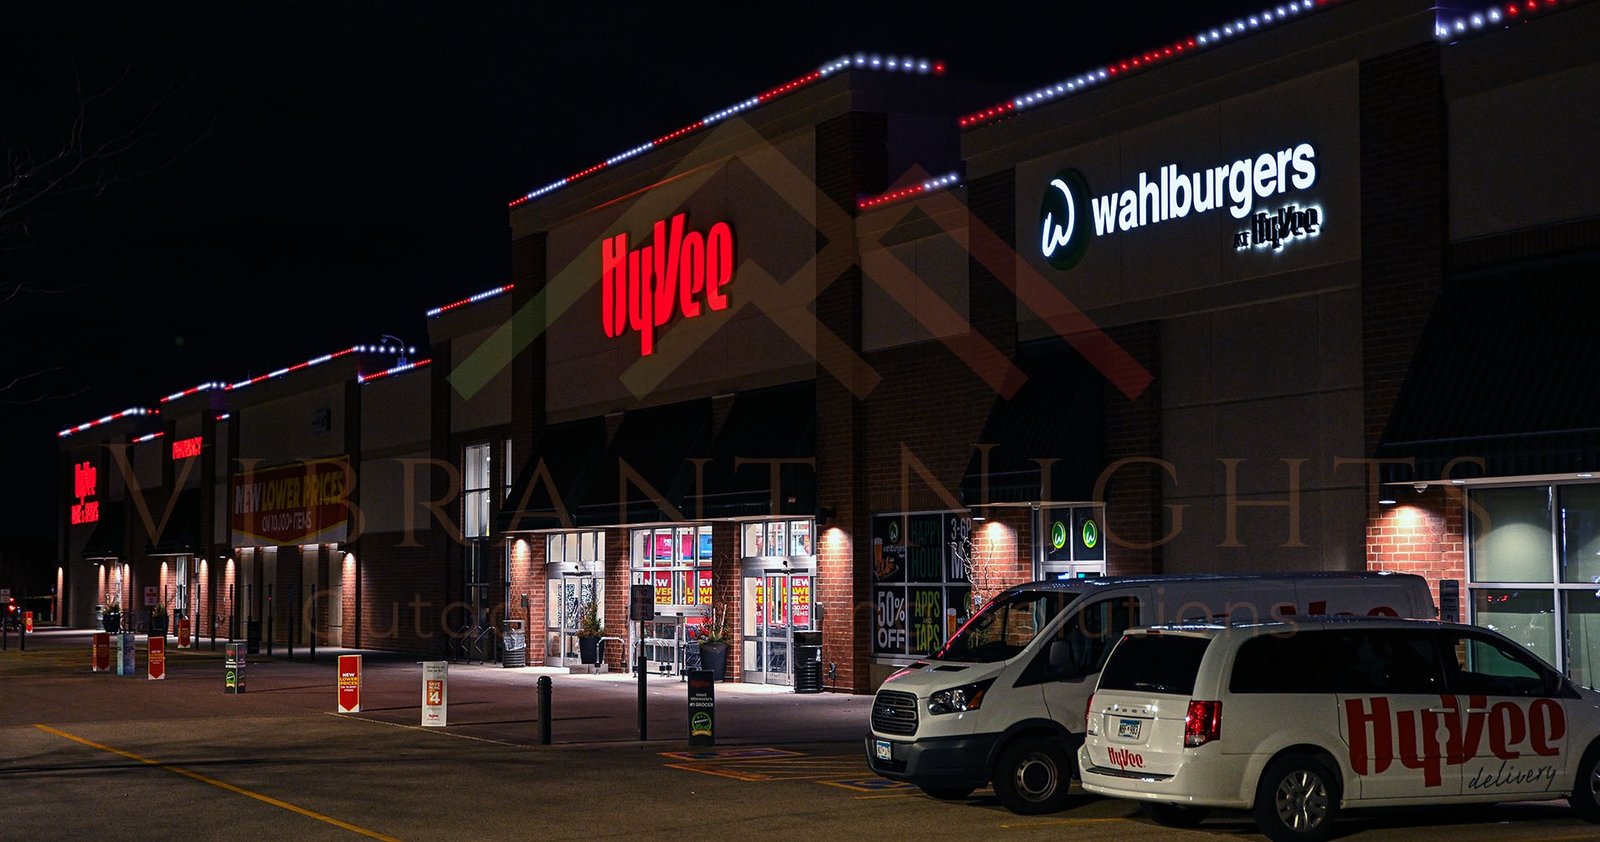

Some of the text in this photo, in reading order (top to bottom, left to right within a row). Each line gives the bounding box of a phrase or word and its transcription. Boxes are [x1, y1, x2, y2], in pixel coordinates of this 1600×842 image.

[1091, 142, 1317, 237] wahlburgers
[1251, 205, 1320, 249] HyVee
[602, 212, 734, 357] HyVee
[234, 470, 345, 514] NEW LOWER PRICES
[911, 519, 942, 545] HAPPY
[911, 546, 942, 578] HOUR
[877, 590, 905, 628] 50%
[914, 590, 941, 618] APPS
[877, 626, 905, 649] OFF
[914, 623, 941, 652] TAPS
[1344, 691, 1567, 787] HyVee
[1107, 747, 1143, 770] HyVee
[1468, 760, 1556, 792] delivery
